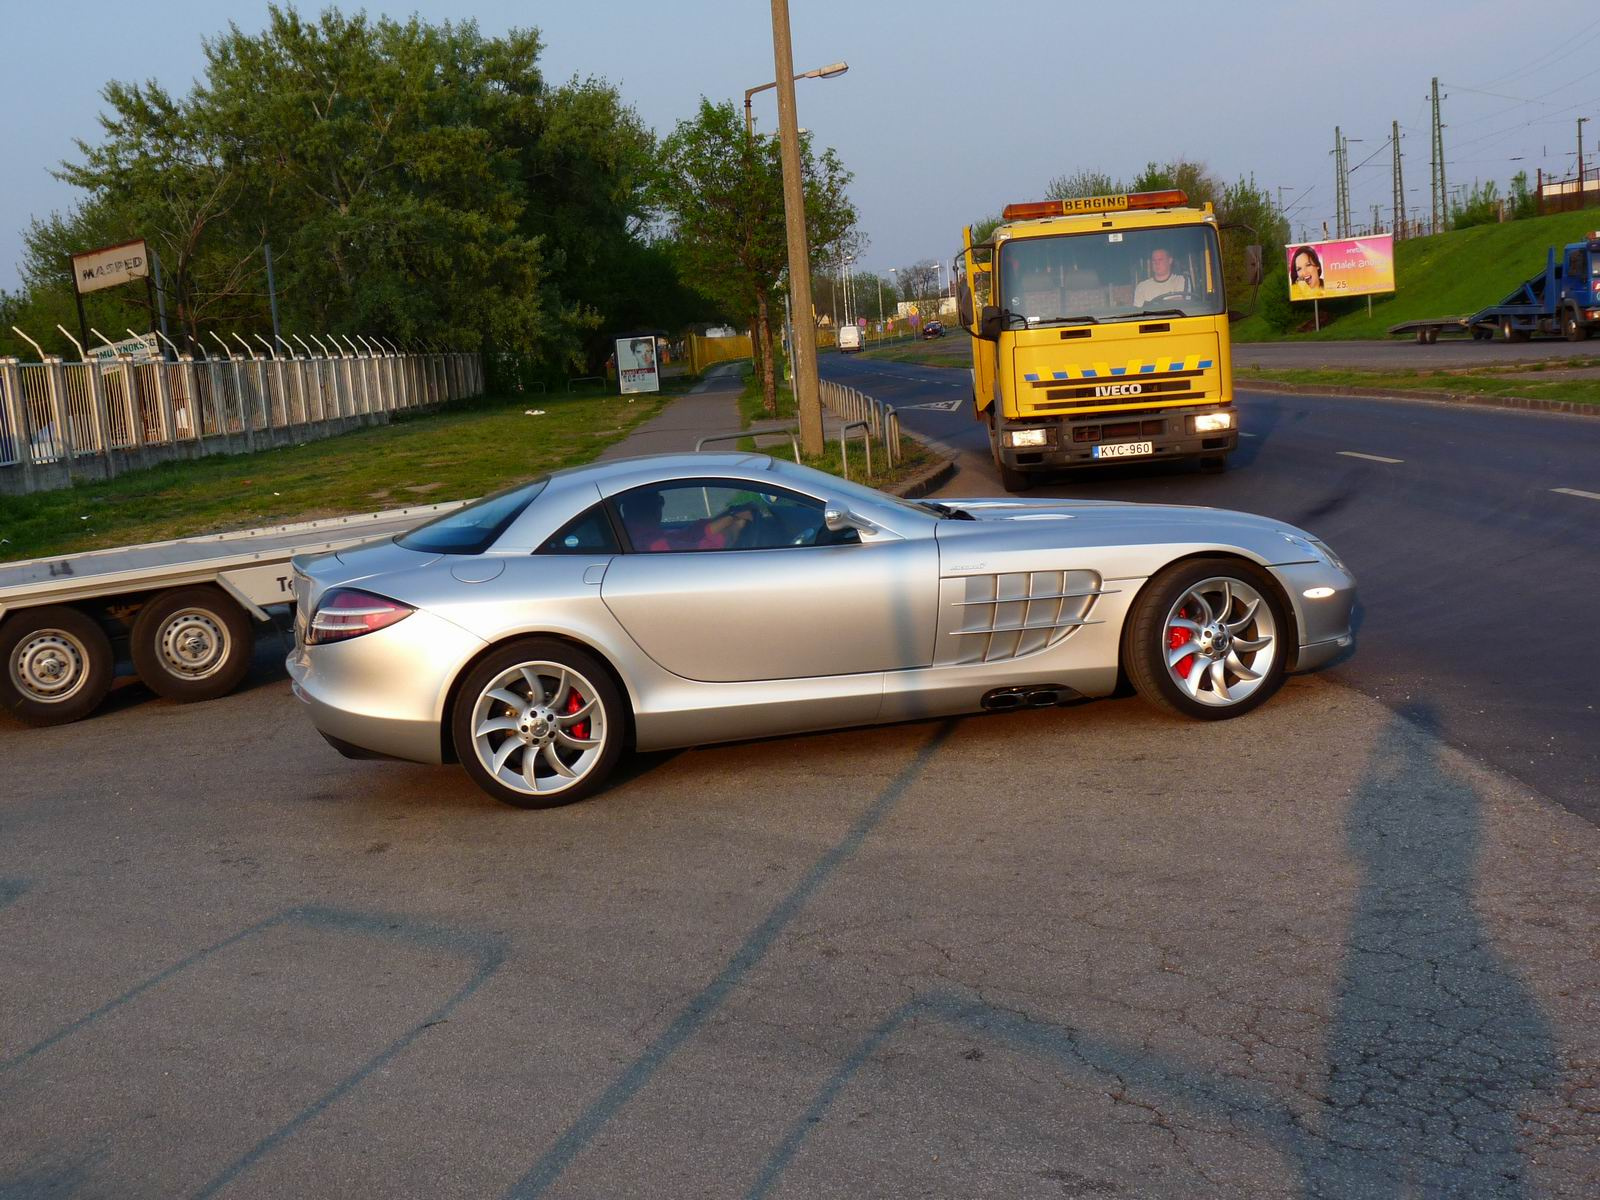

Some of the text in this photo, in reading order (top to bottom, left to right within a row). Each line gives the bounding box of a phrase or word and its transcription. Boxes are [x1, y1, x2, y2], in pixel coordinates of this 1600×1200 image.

[1064, 197, 1126, 210] BERGING
[82, 256, 143, 281] MASPED
[1095, 384, 1142, 397] IVECO
[1101, 443, 1150, 457] KYC-960
